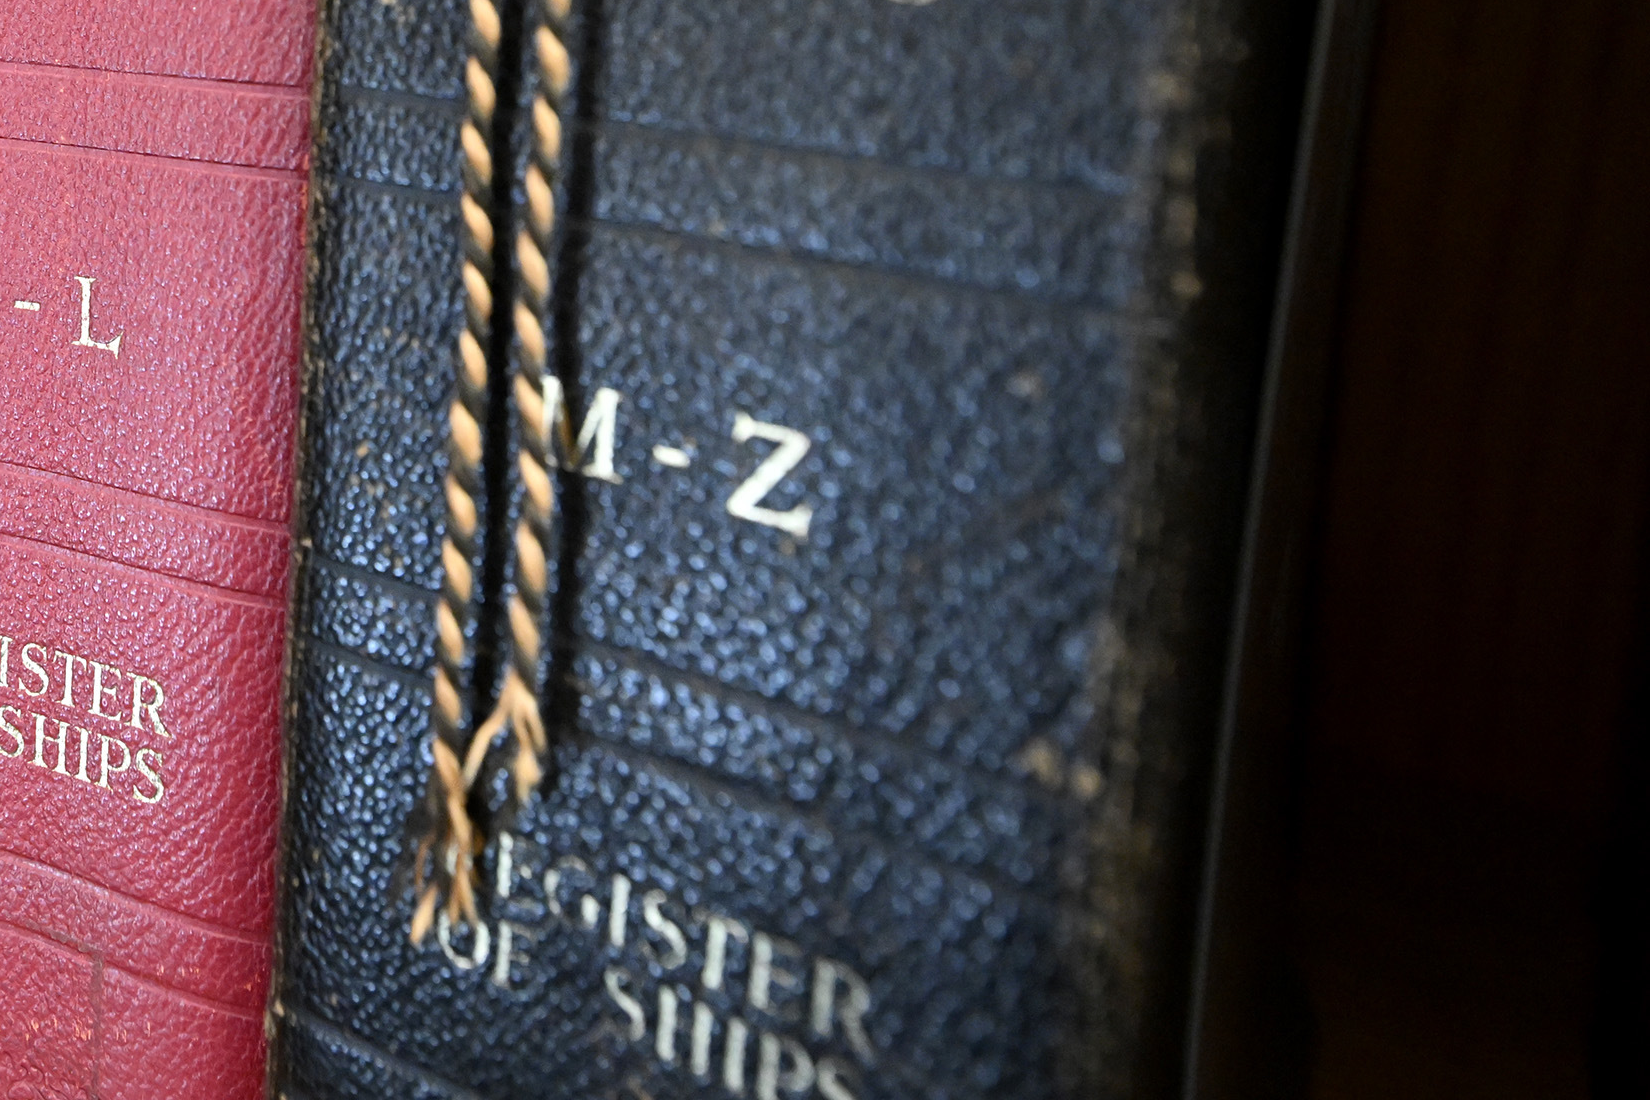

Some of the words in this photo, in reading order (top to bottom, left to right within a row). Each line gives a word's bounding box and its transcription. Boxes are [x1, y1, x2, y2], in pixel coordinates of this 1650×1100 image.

[72, 276, 124, 359] L
[726, 410, 814, 541] Z
[445, 830, 876, 1067] EGISTER
